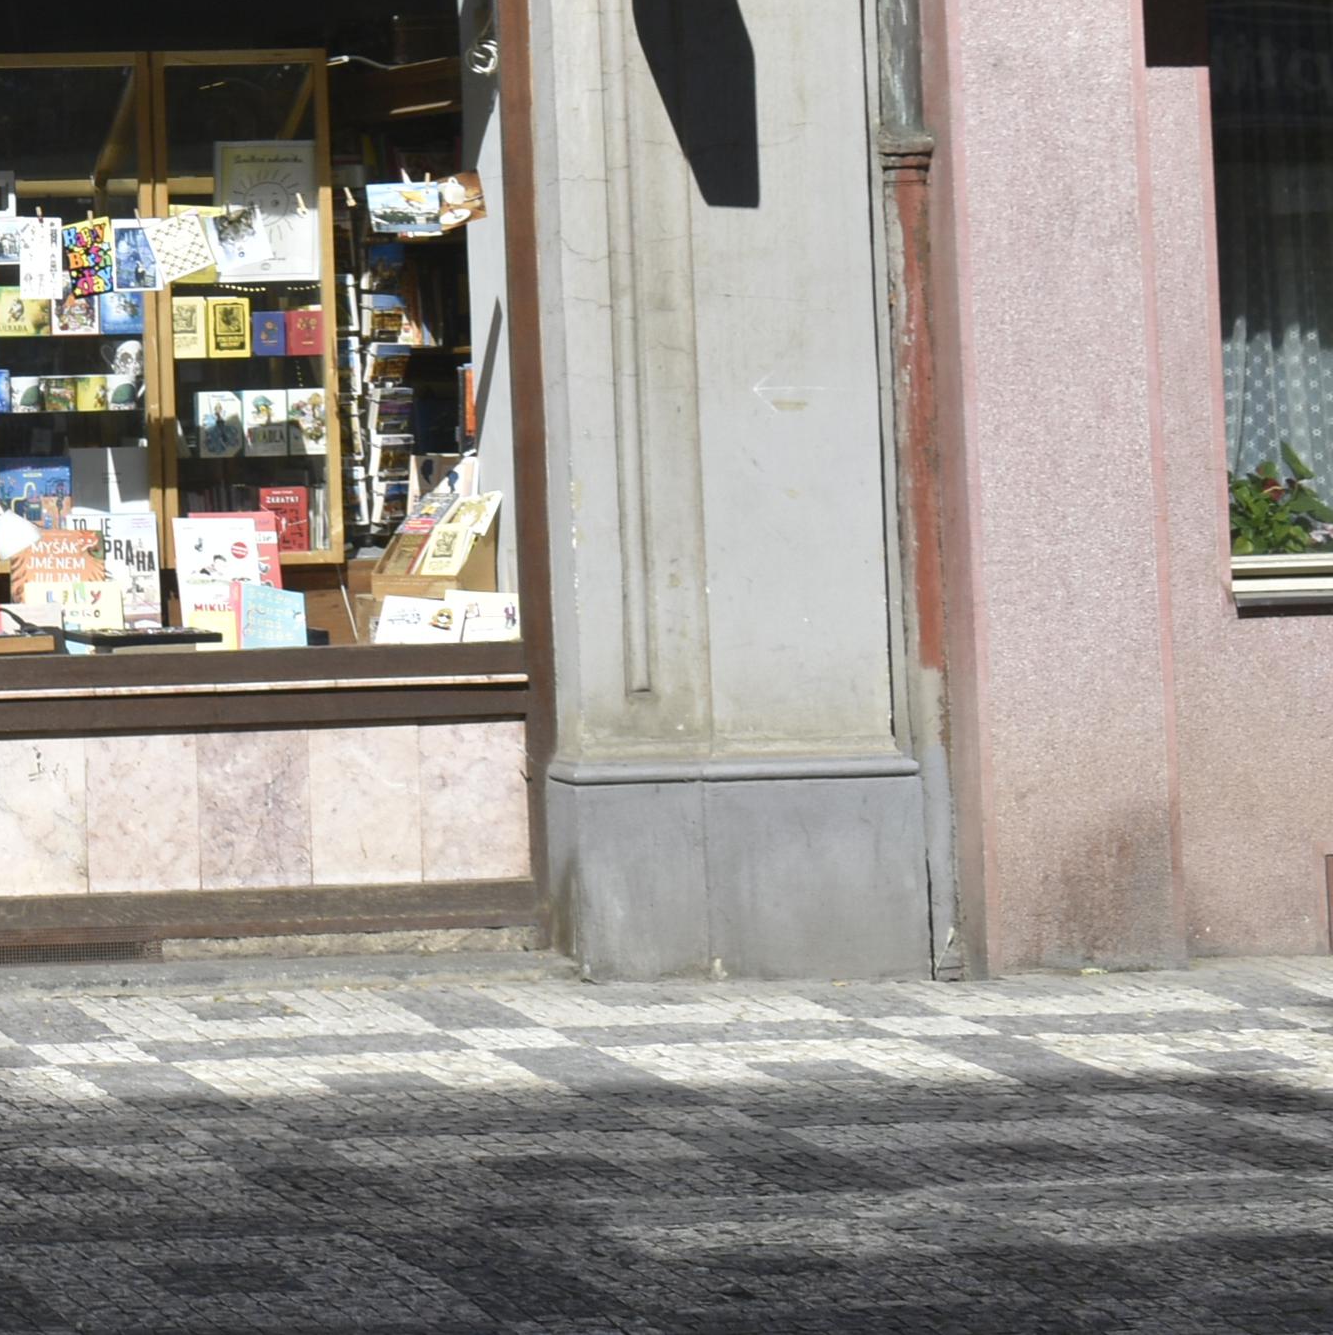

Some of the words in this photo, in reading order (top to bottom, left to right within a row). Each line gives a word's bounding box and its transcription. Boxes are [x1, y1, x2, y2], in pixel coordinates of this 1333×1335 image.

[31, 535, 79, 555] MYŠÁK
[25, 551, 86, 570] JMÉNEM
[103, 539, 156, 572] PRAHA
